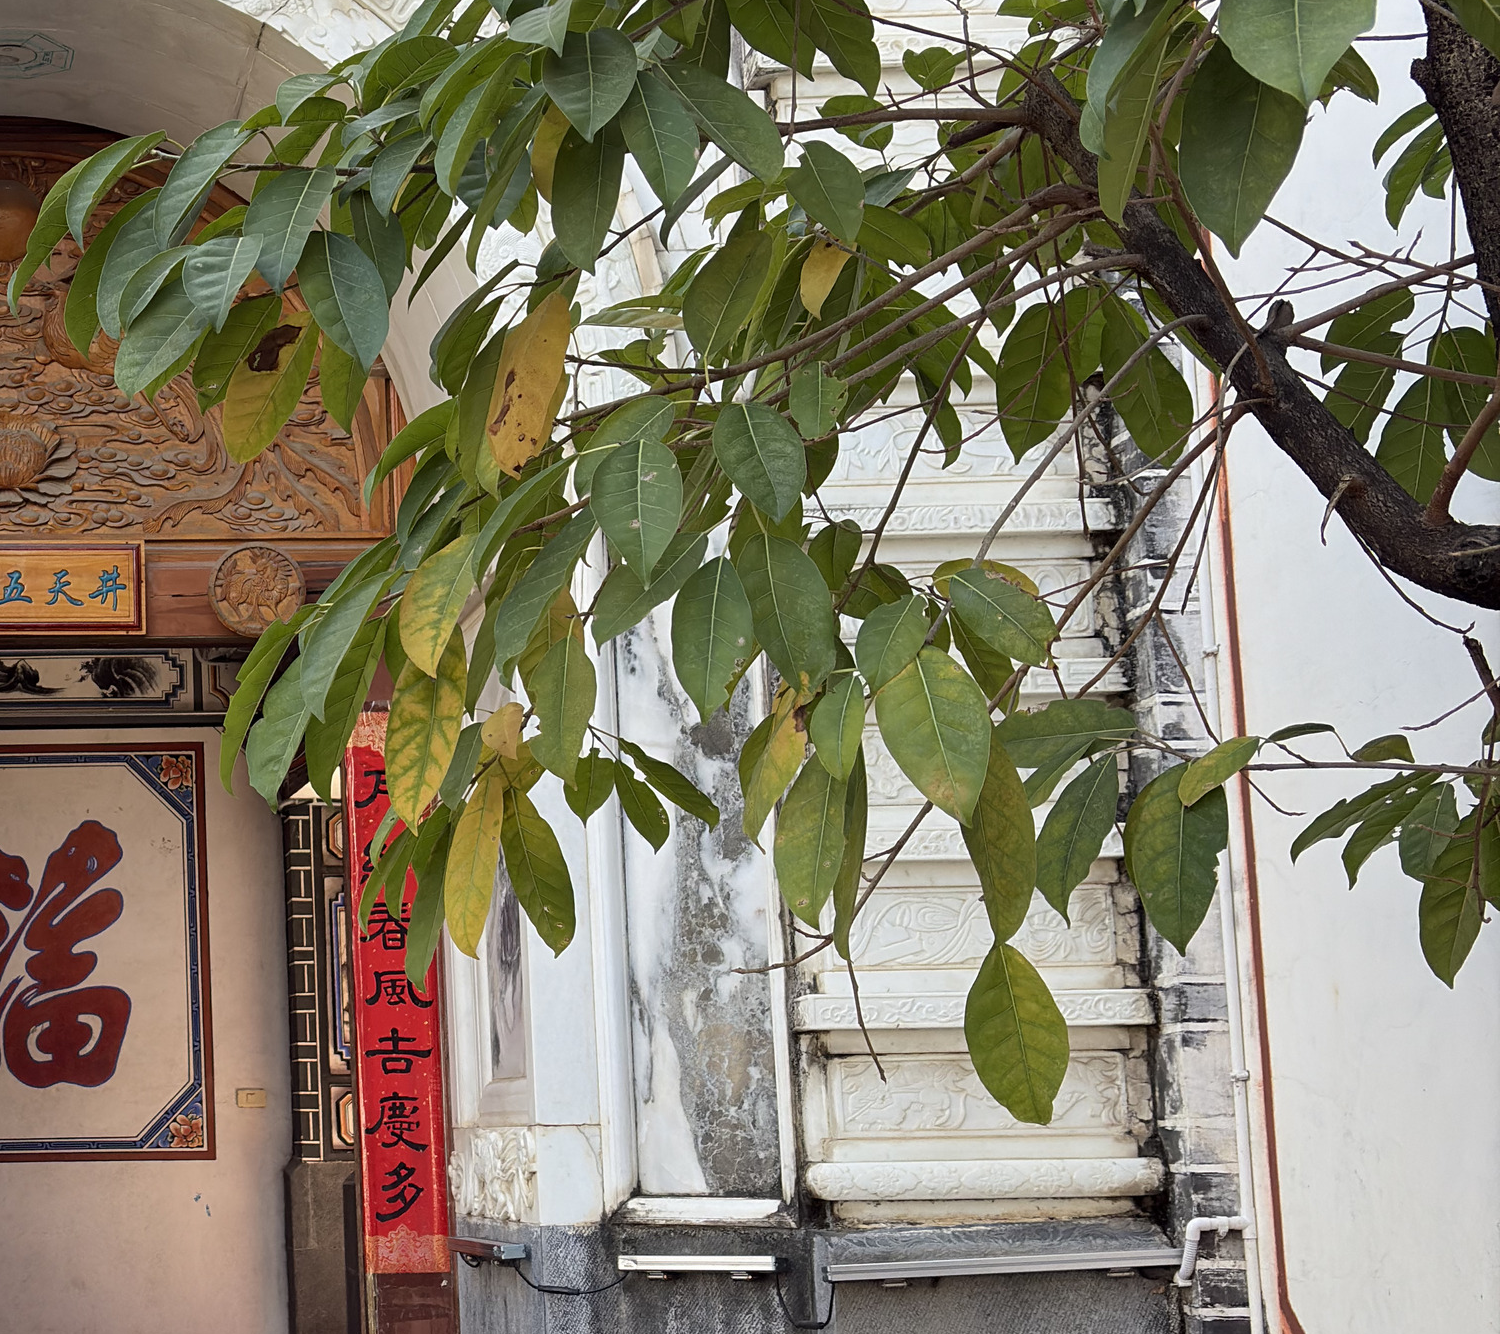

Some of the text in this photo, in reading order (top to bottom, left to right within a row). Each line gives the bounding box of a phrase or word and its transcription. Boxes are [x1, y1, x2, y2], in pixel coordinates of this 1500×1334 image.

[354, 769, 435, 1223] 春風吉慶多
